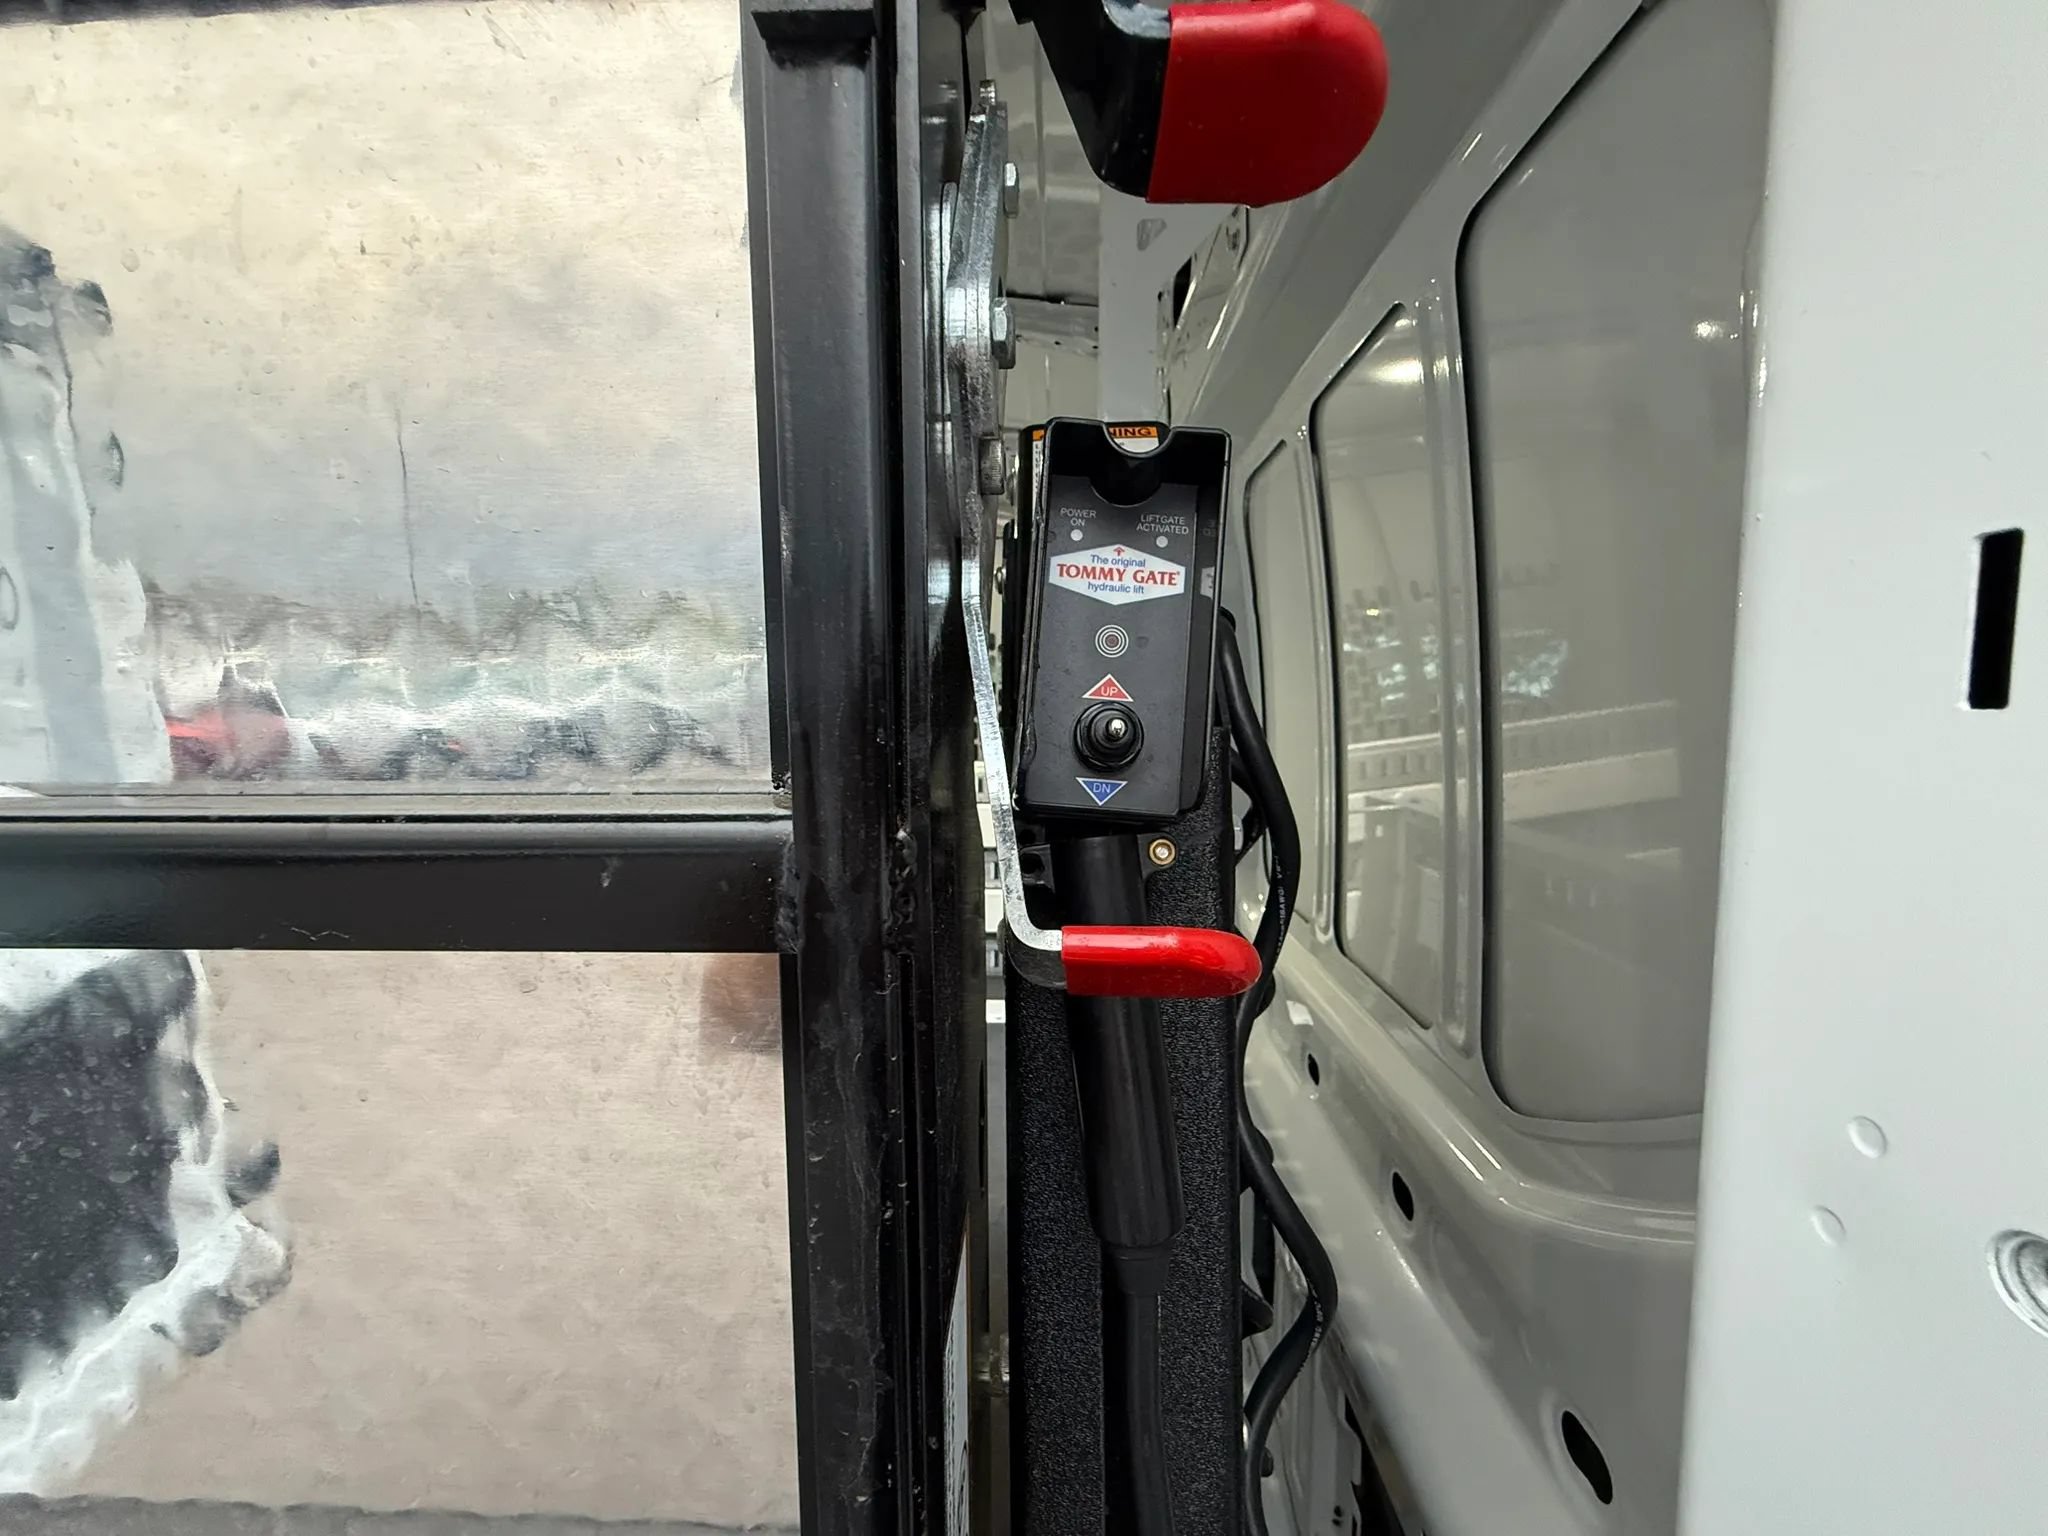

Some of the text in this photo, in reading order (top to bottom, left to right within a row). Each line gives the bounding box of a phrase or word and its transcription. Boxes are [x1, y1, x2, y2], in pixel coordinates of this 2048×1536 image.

[1060, 507, 1097, 518] POWER
[1070, 518, 1085, 527] ON
[1140, 514, 1185, 525] LIFTGATE
[1136, 524, 1189, 535] ACTIVATED
[1090, 554, 1146, 568] The original
[1056, 563, 1126, 582] TOMMY
[1087, 582, 1145, 595] hydraulic lift
[1101, 686, 1119, 697] UP
[1092, 782, 1111, 794] DN
